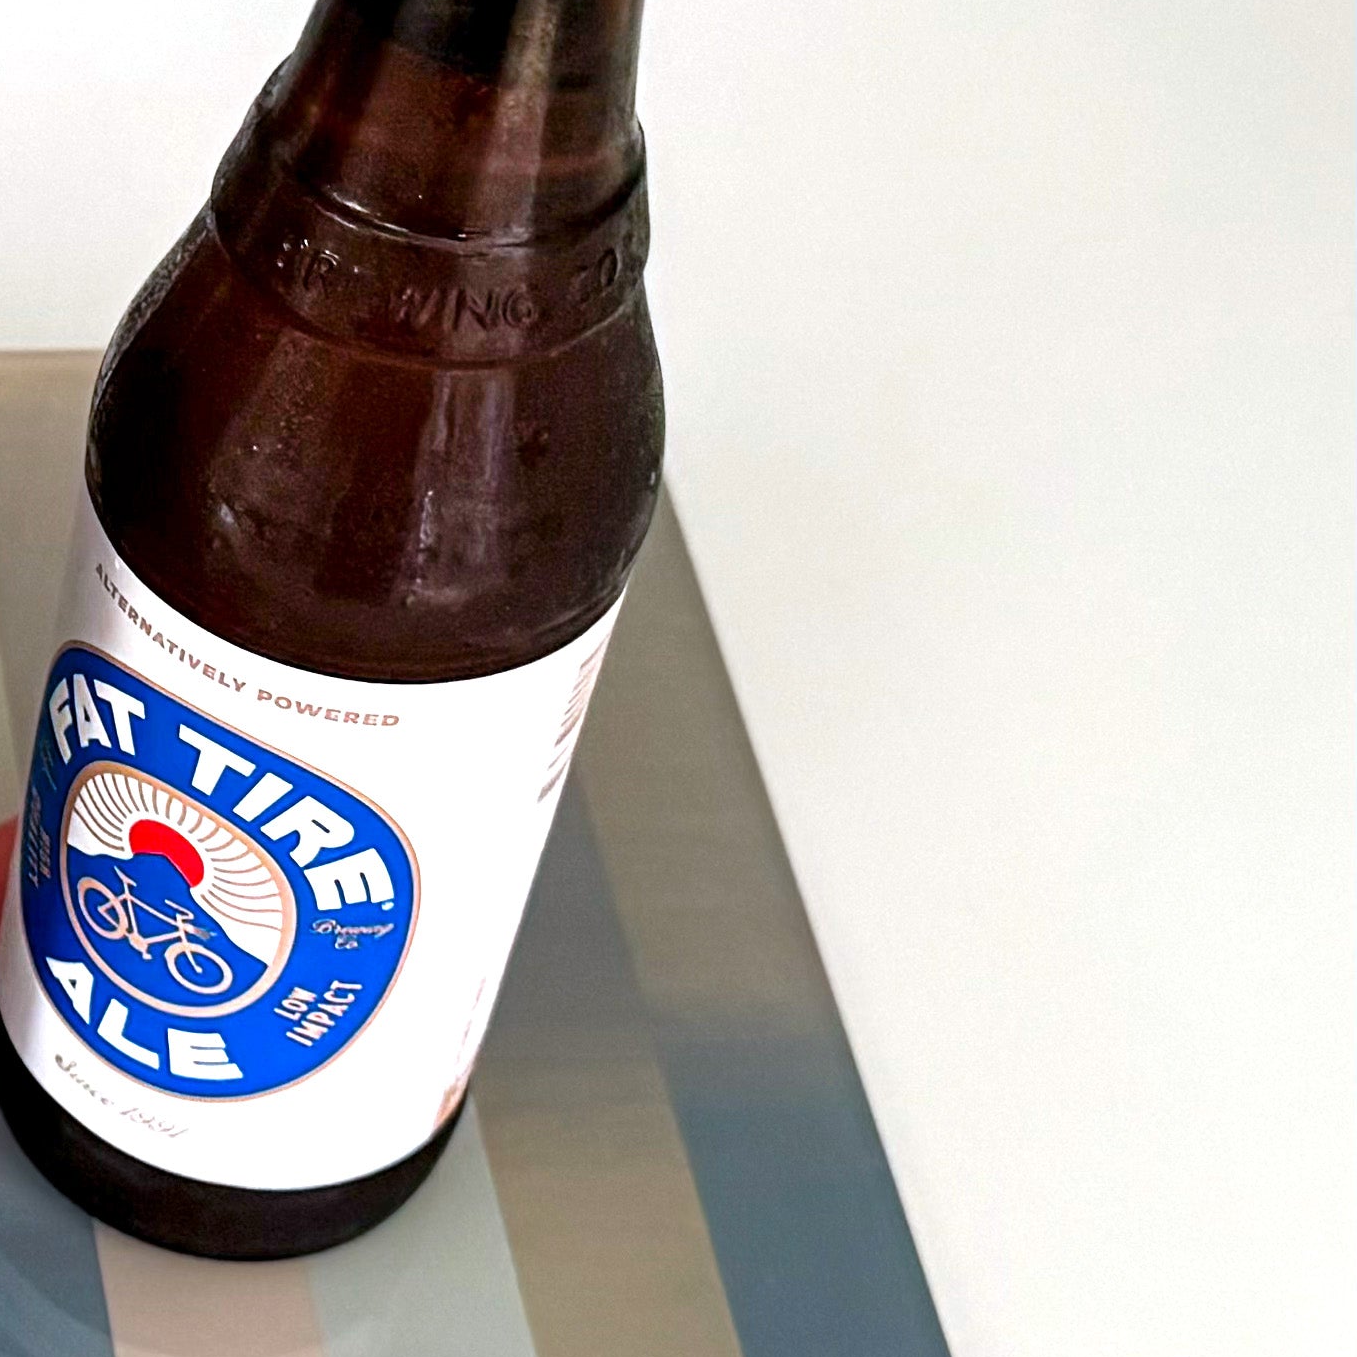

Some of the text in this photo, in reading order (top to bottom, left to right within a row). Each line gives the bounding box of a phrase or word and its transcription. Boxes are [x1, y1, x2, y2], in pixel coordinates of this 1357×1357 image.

[95, 563, 399, 727] ALTERNATIVELY POWERED
[48, 673, 146, 763] FAT
[178, 724, 394, 912] TIRE
[46, 956, 244, 1080] ALE
[273, 986, 317, 1021] LOW
[286, 980, 363, 1047] IMPACT
